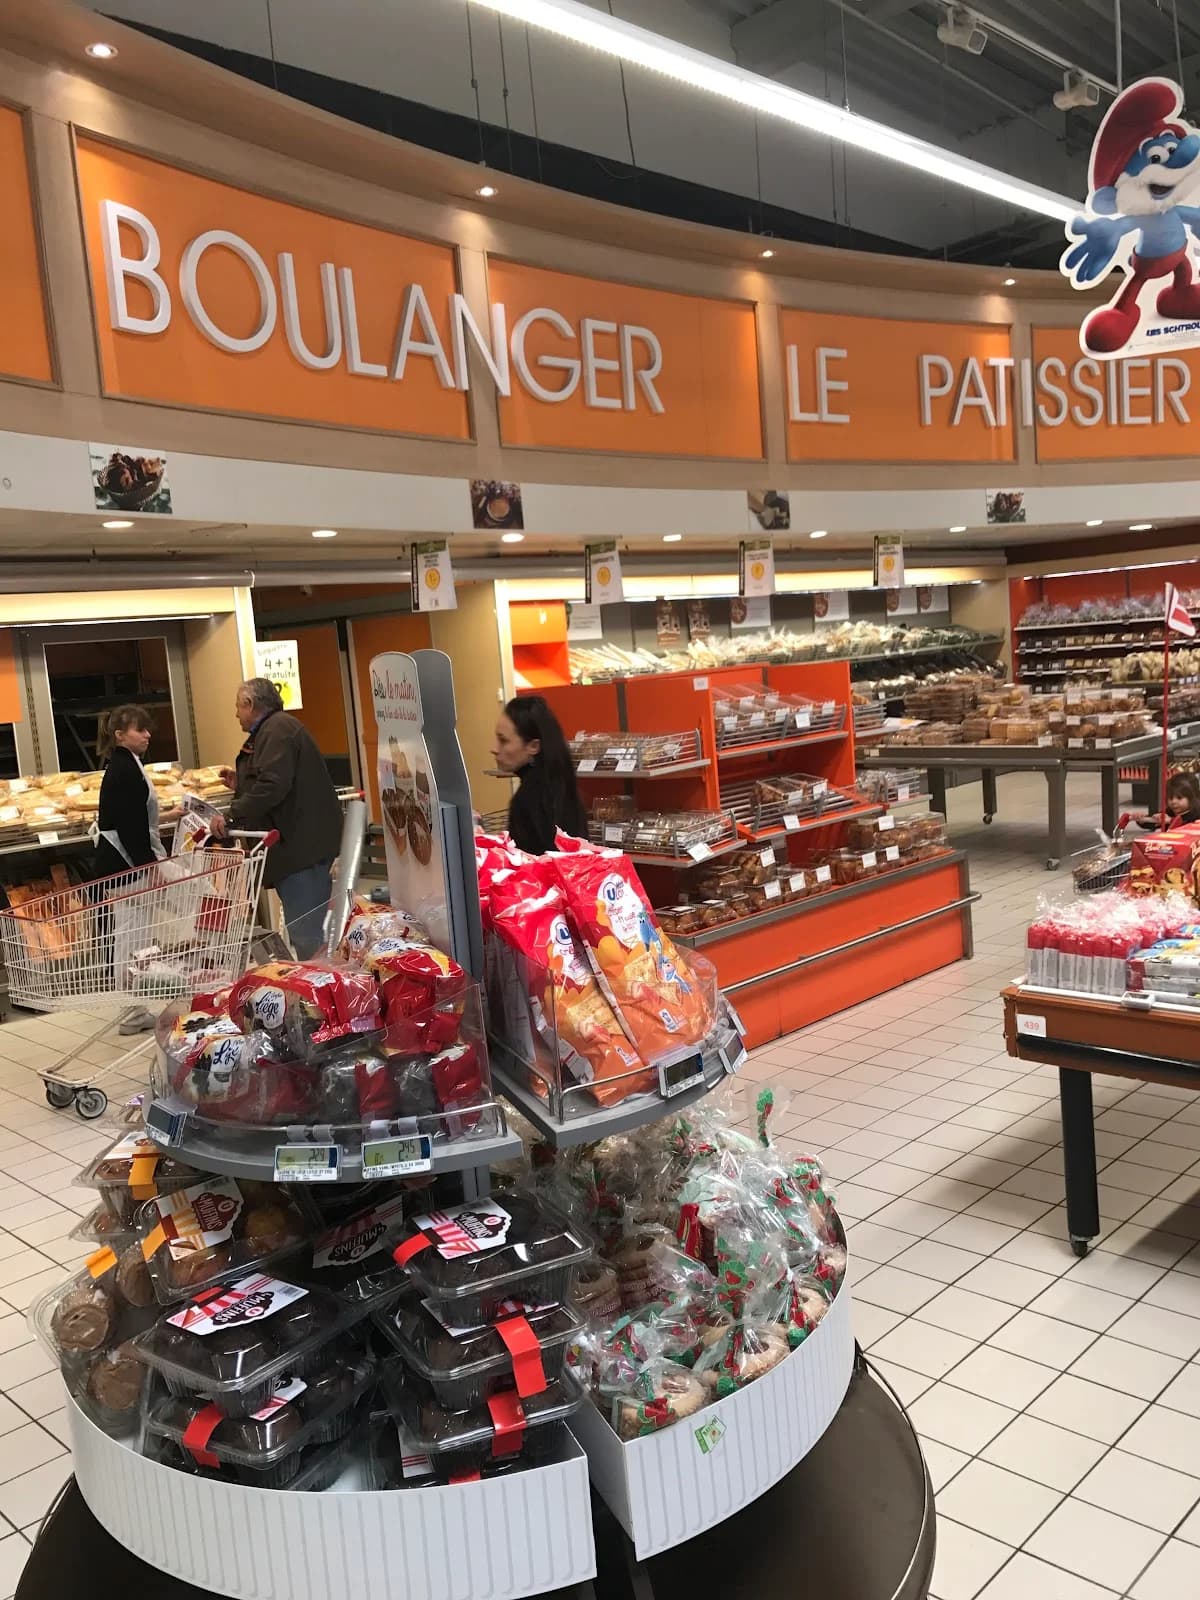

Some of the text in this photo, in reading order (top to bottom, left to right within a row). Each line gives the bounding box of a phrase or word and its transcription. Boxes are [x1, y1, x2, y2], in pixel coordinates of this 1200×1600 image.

[101, 199, 1191, 428] BOULANGER LE PATISSIER
[264, 658, 272, 669] 4
[334, 1225, 379, 1257] MUFFINS
[215, 1292, 267, 1323] MUFFINS
